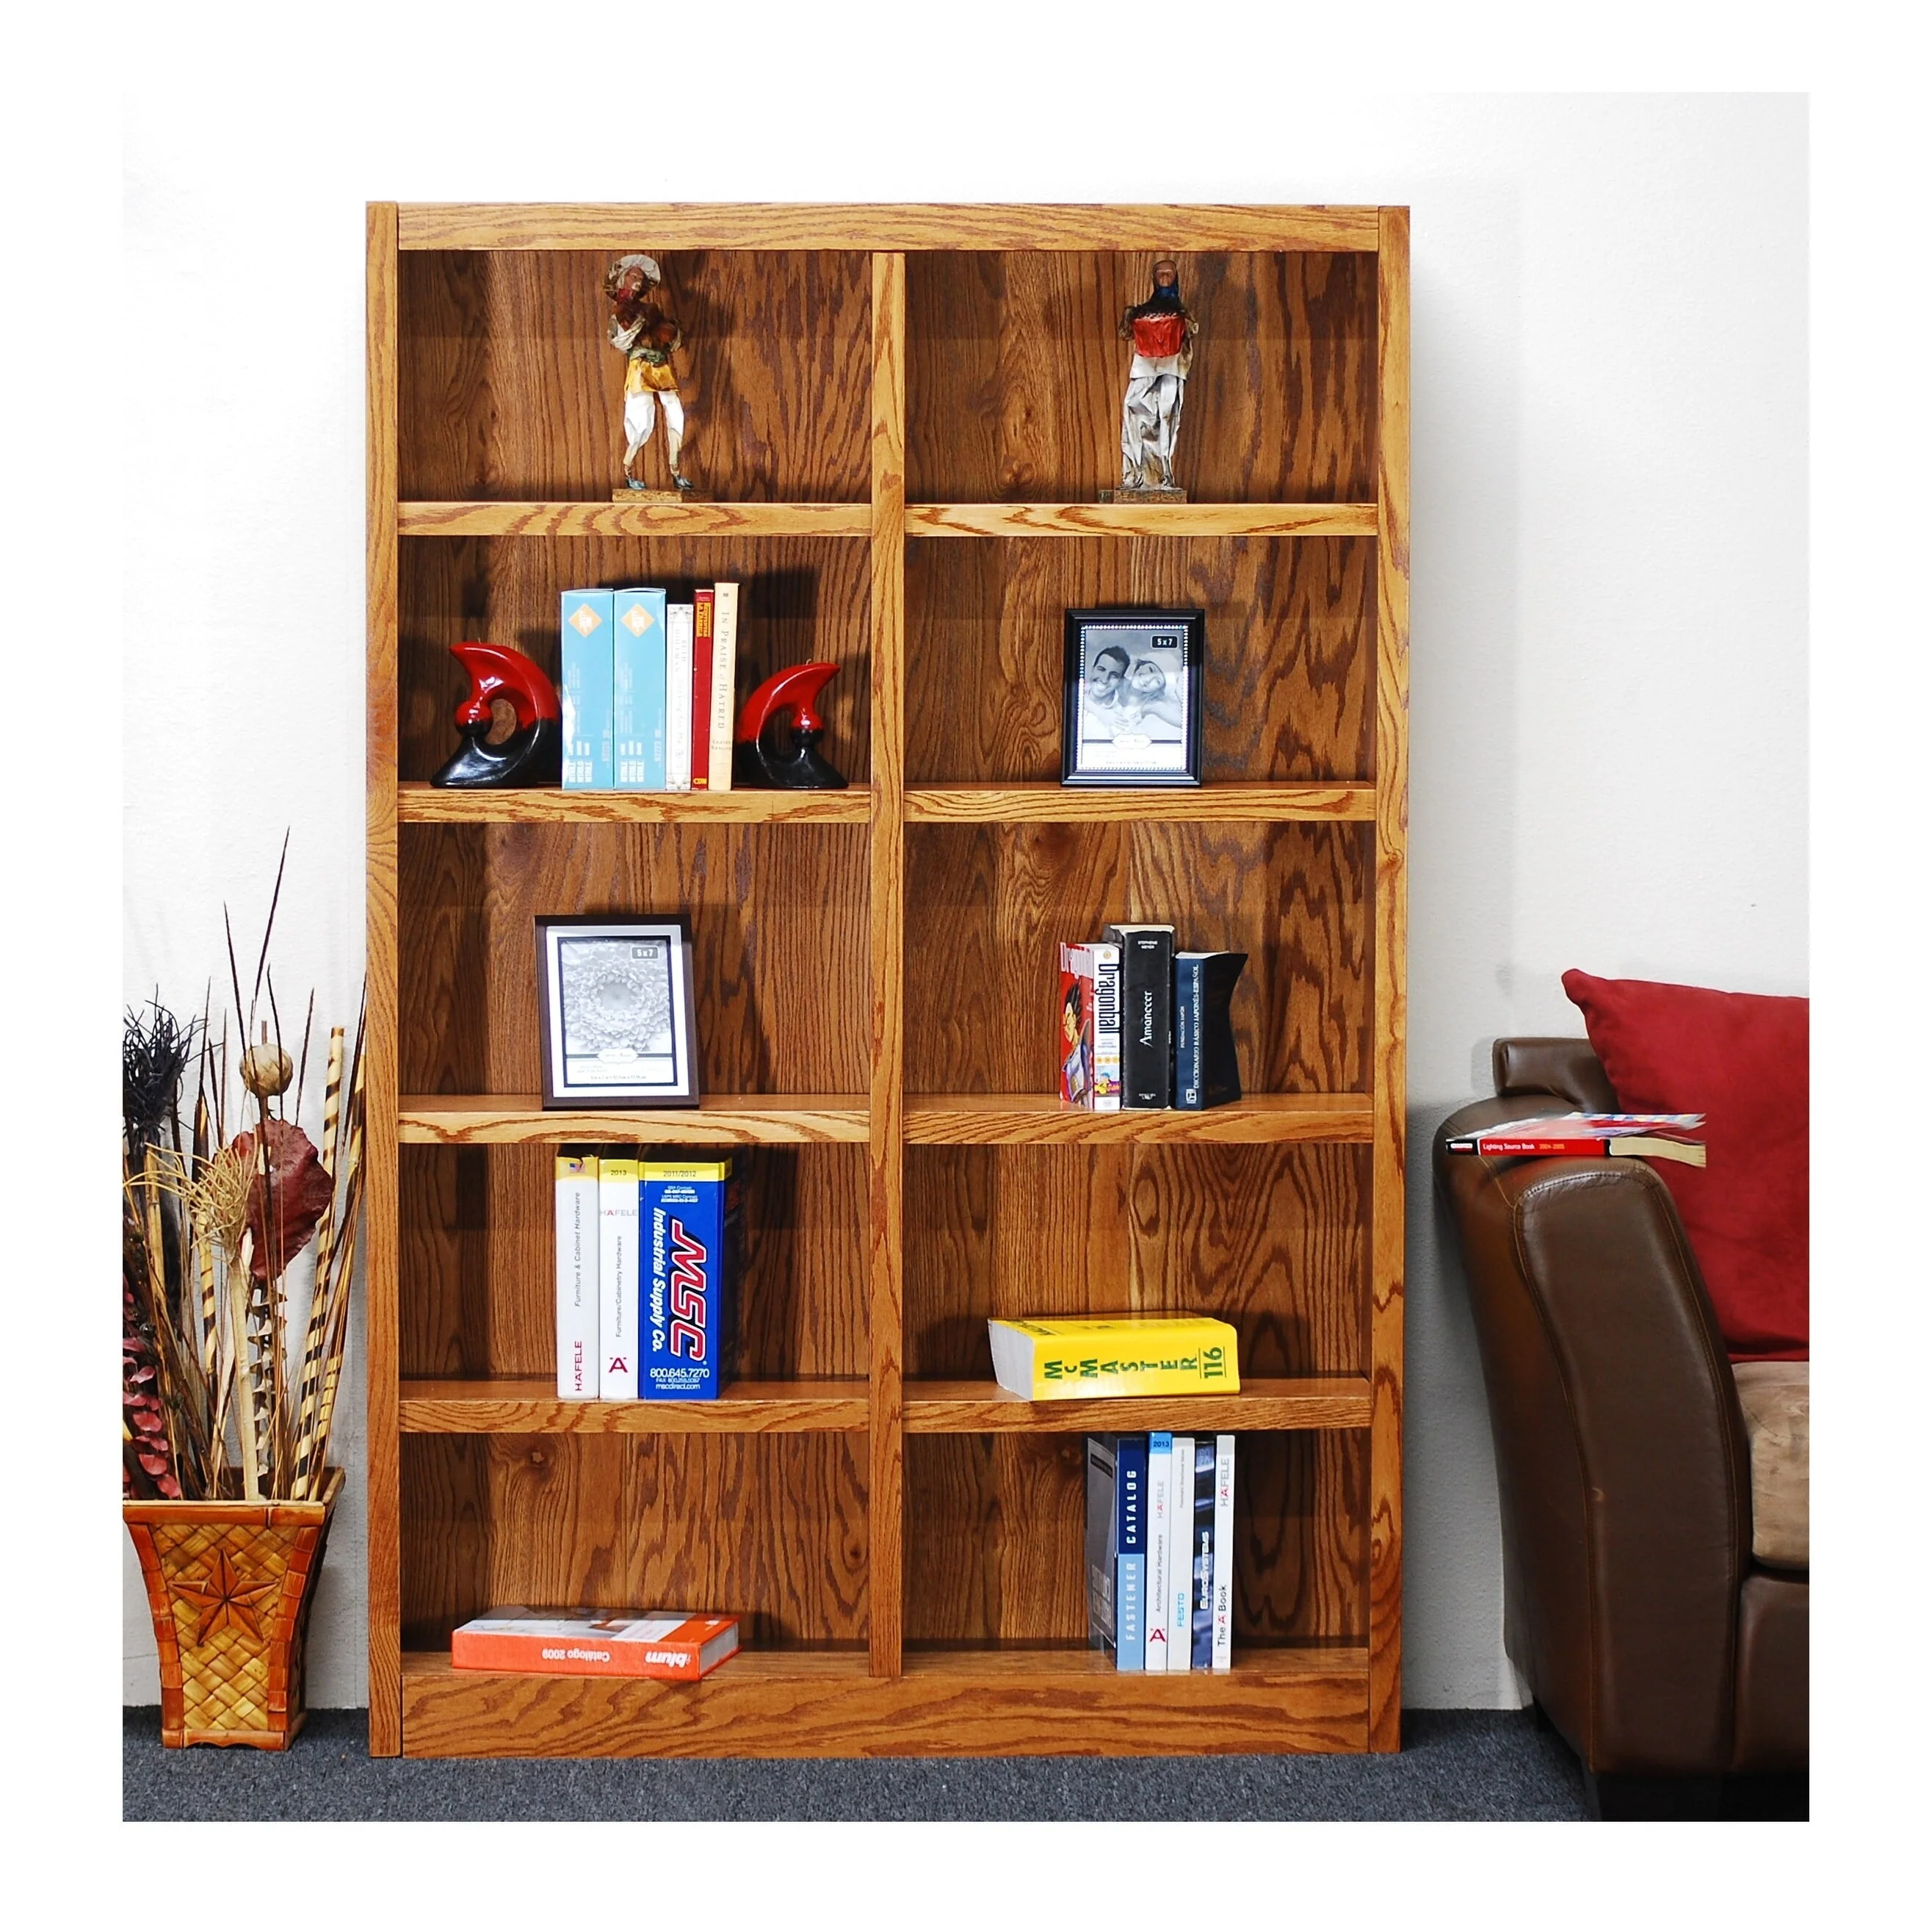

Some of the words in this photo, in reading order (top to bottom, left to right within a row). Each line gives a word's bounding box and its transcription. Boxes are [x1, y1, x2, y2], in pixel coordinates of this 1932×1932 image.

[721, 611, 729, 623] IN
[719, 630, 728, 669] PRAISE
[717, 683, 728, 729] HATRED
[1094, 963, 1120, 1034] Dragonball
[1483, 1143, 1503, 1151] Lighting
[652, 1207, 667, 1278] Industrial
[670, 1218, 707, 1361] MSC
[649, 1279, 667, 1330] Supply
[652, 1331, 666, 1352] Co.
[650, 1368, 709, 1378] 800.645.7270
[1203, 1347, 1223, 1378] 116
[1126, 1469, 1137, 1544] CATALOG
[1126, 1562, 1136, 1641] FASTENER
[1218, 1584, 1227, 1611] Book
[1218, 1627, 1226, 1647] The
[542, 1649, 565, 1660] 2009
[568, 1649, 611, 1663] Catálogo
[645, 1651, 689, 1668] blum
